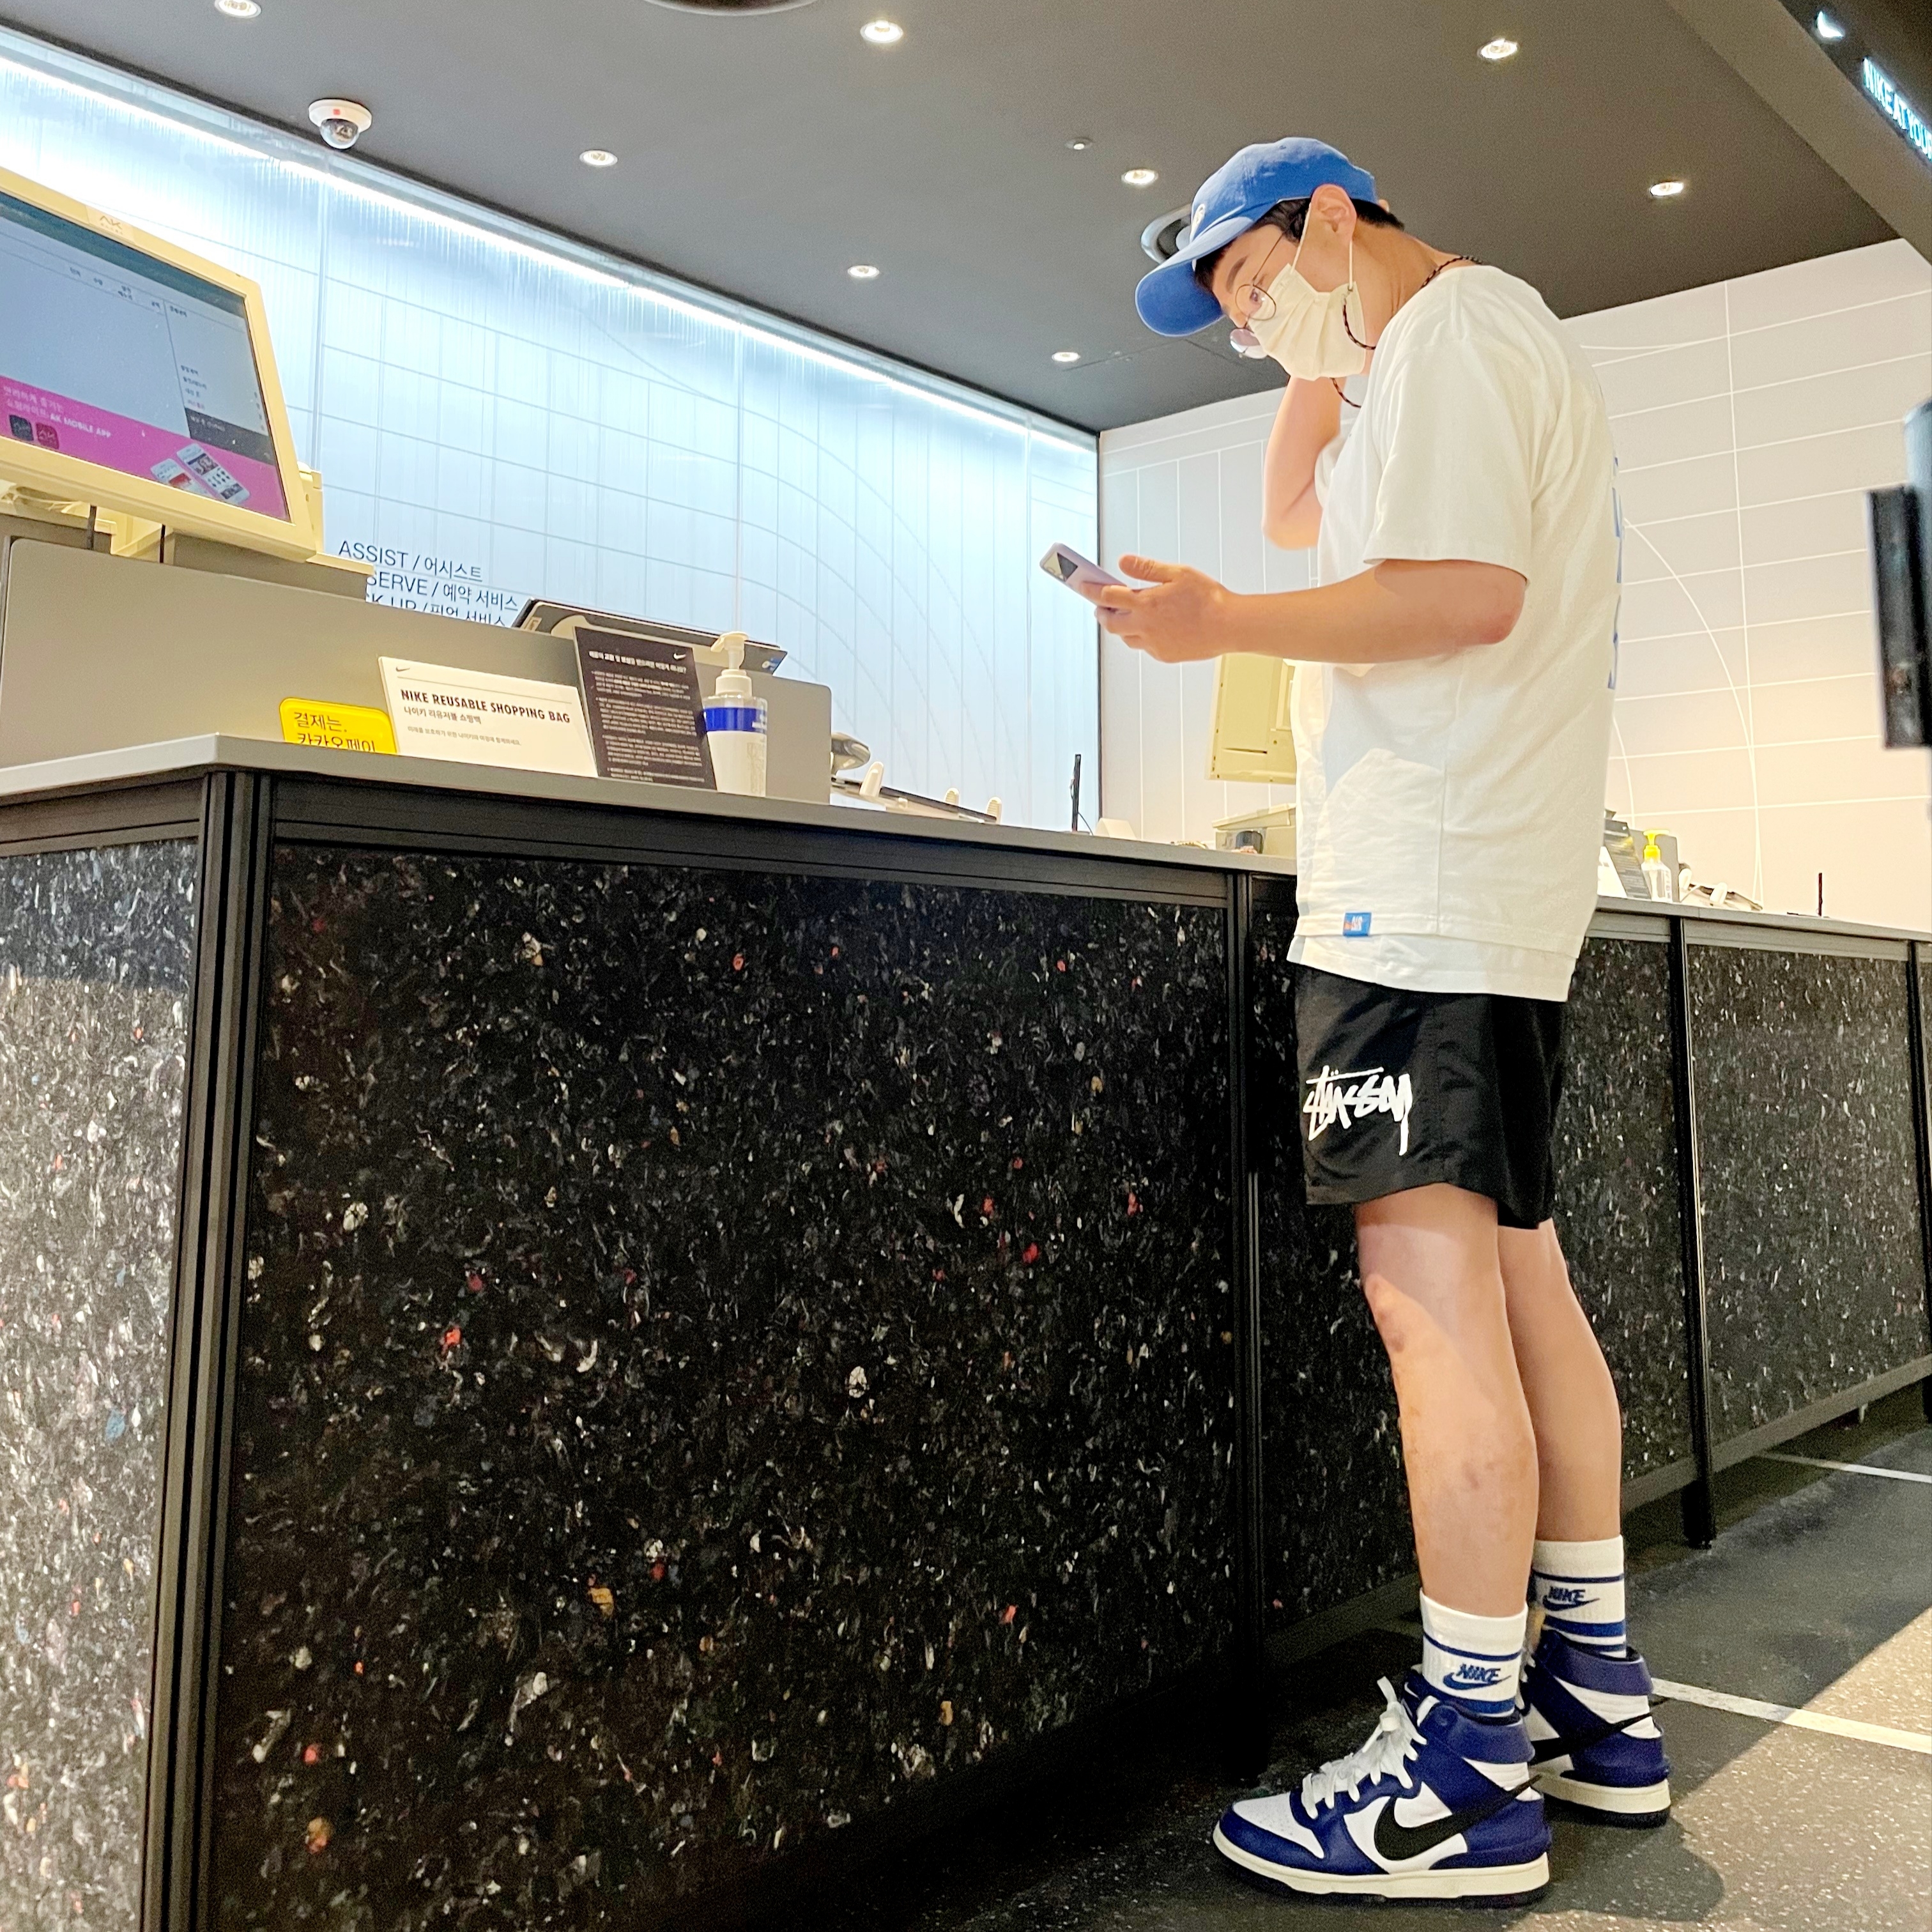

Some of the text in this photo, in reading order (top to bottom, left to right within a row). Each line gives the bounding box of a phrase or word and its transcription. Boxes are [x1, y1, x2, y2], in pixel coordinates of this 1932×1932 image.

[1862, 57, 1894, 116] NIKE
[64, 417, 93, 434] MOBILE
[96, 427, 111, 438] APP
[339, 540, 409, 568] ASSIST
[424, 556, 482, 582] 어시스트
[443, 584, 472, 605] 예약
[476, 590, 518, 611] 서비스
[401, 689, 570, 723] NIKE REUSABLE SHOPPING BAG
[404, 706, 427, 717] 나이키
[1549, 1586, 1586, 1602] NIKE
[1456, 1664, 1501, 1682] NIKE
